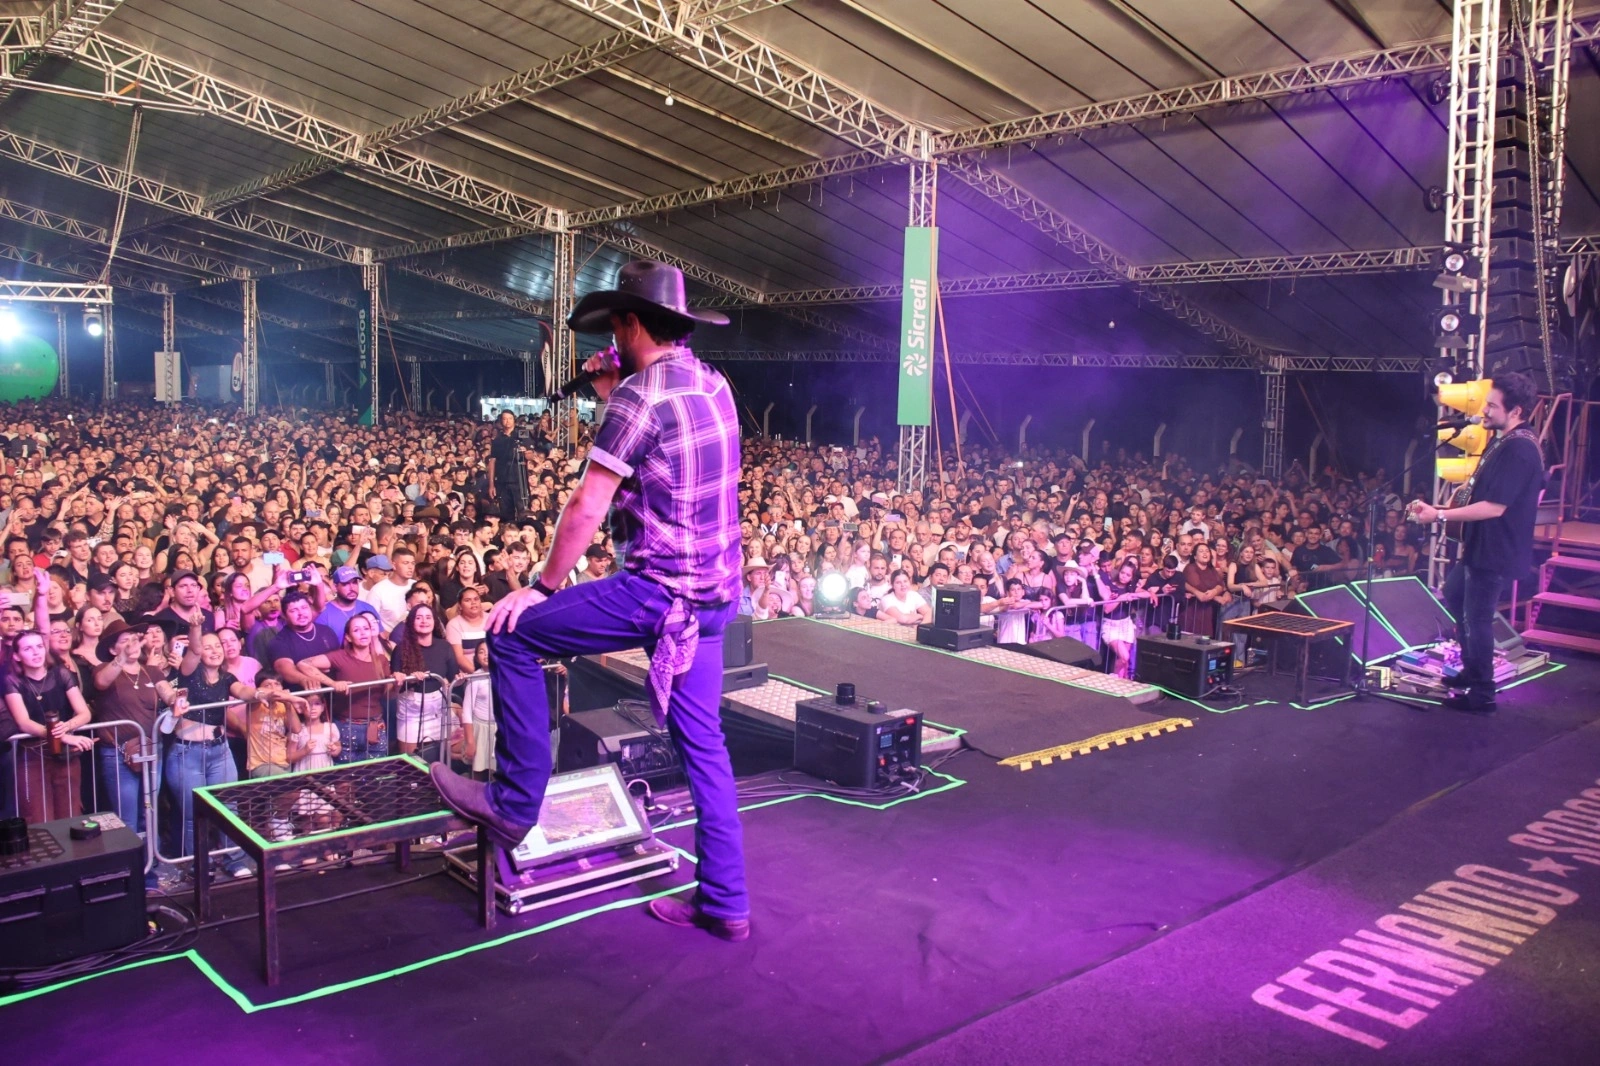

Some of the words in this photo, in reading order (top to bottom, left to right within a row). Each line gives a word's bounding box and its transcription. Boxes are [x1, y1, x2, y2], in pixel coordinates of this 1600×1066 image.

[358, 308, 367, 369] SICOOB
[907, 278, 928, 350] Sicredi
[1251, 863, 1580, 1049] FERNANDO
